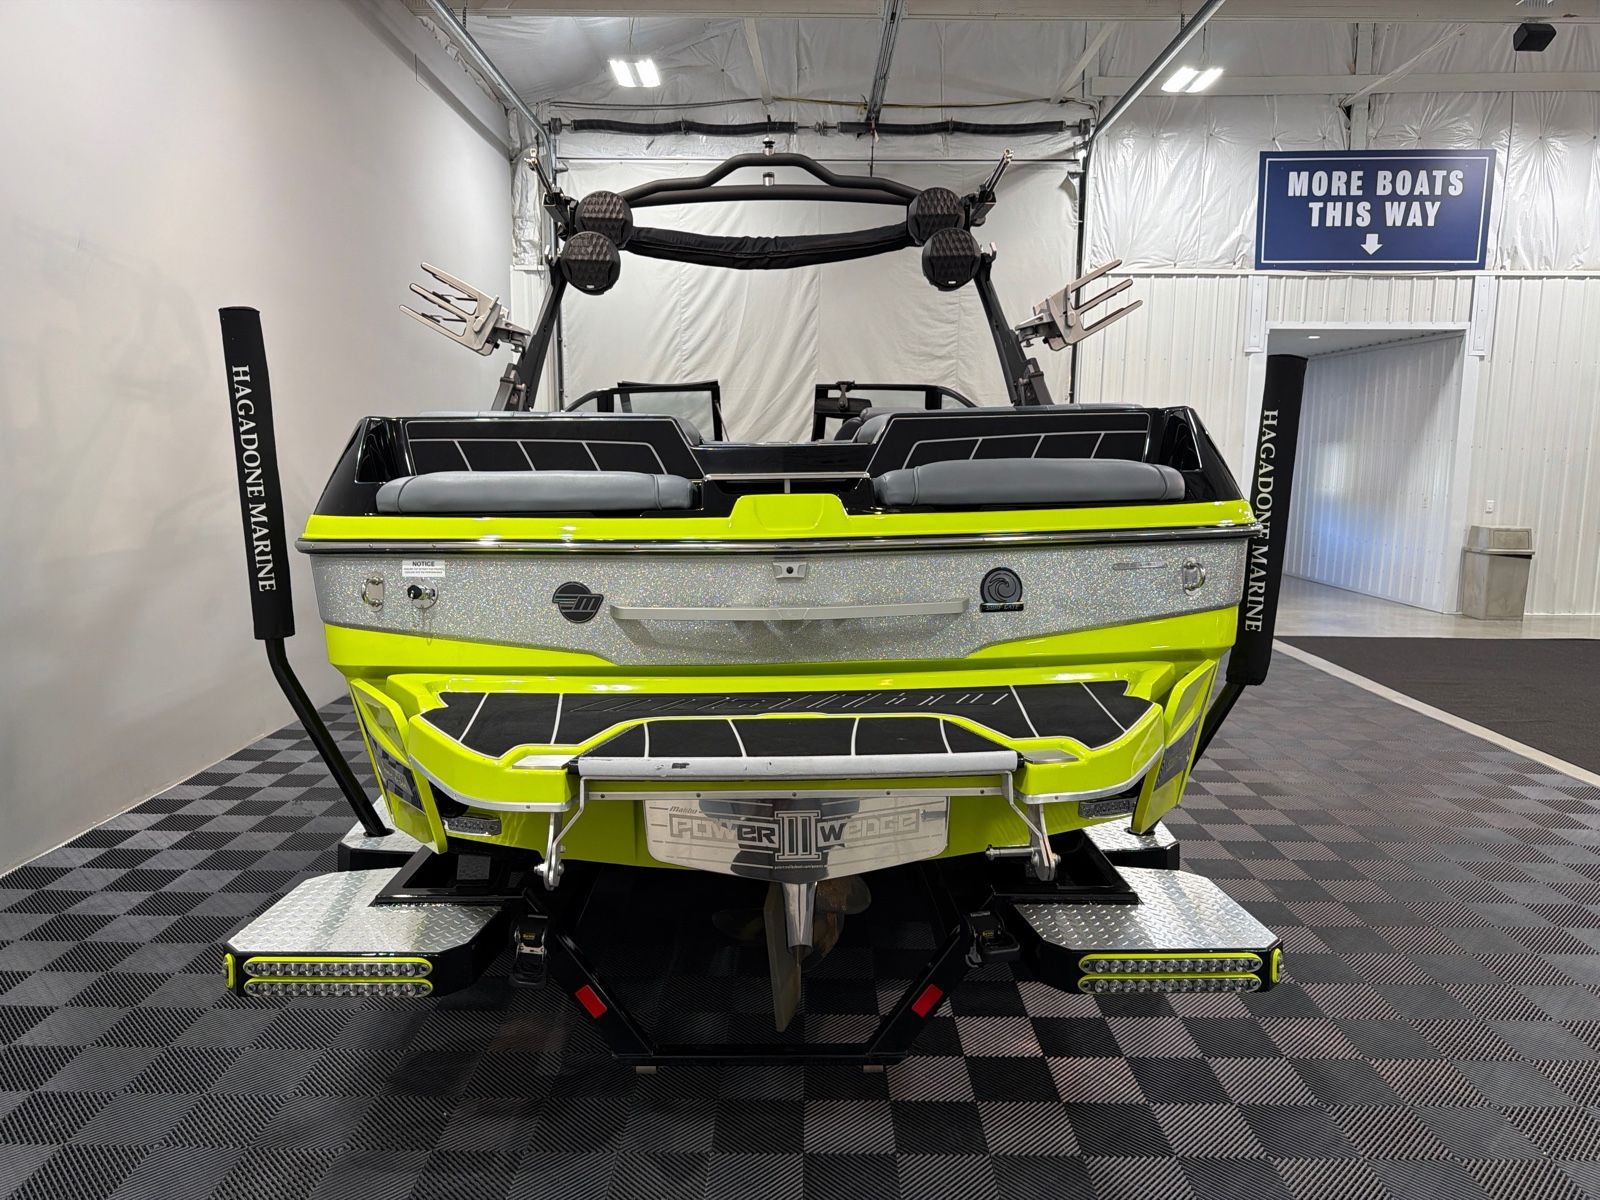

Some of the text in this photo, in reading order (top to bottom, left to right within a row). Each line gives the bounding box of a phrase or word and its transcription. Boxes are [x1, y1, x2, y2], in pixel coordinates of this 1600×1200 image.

[1287, 169, 1464, 197] MORE BOATS
[1308, 201, 1441, 227] THIS WAY
[232, 364, 277, 592] HAGADONE MARINE
[1245, 543, 1269, 632] MARINE
[669, 805, 698, 814] Malibu
[670, 815, 778, 846] POWER
[818, 809, 919, 845] WEDGE
